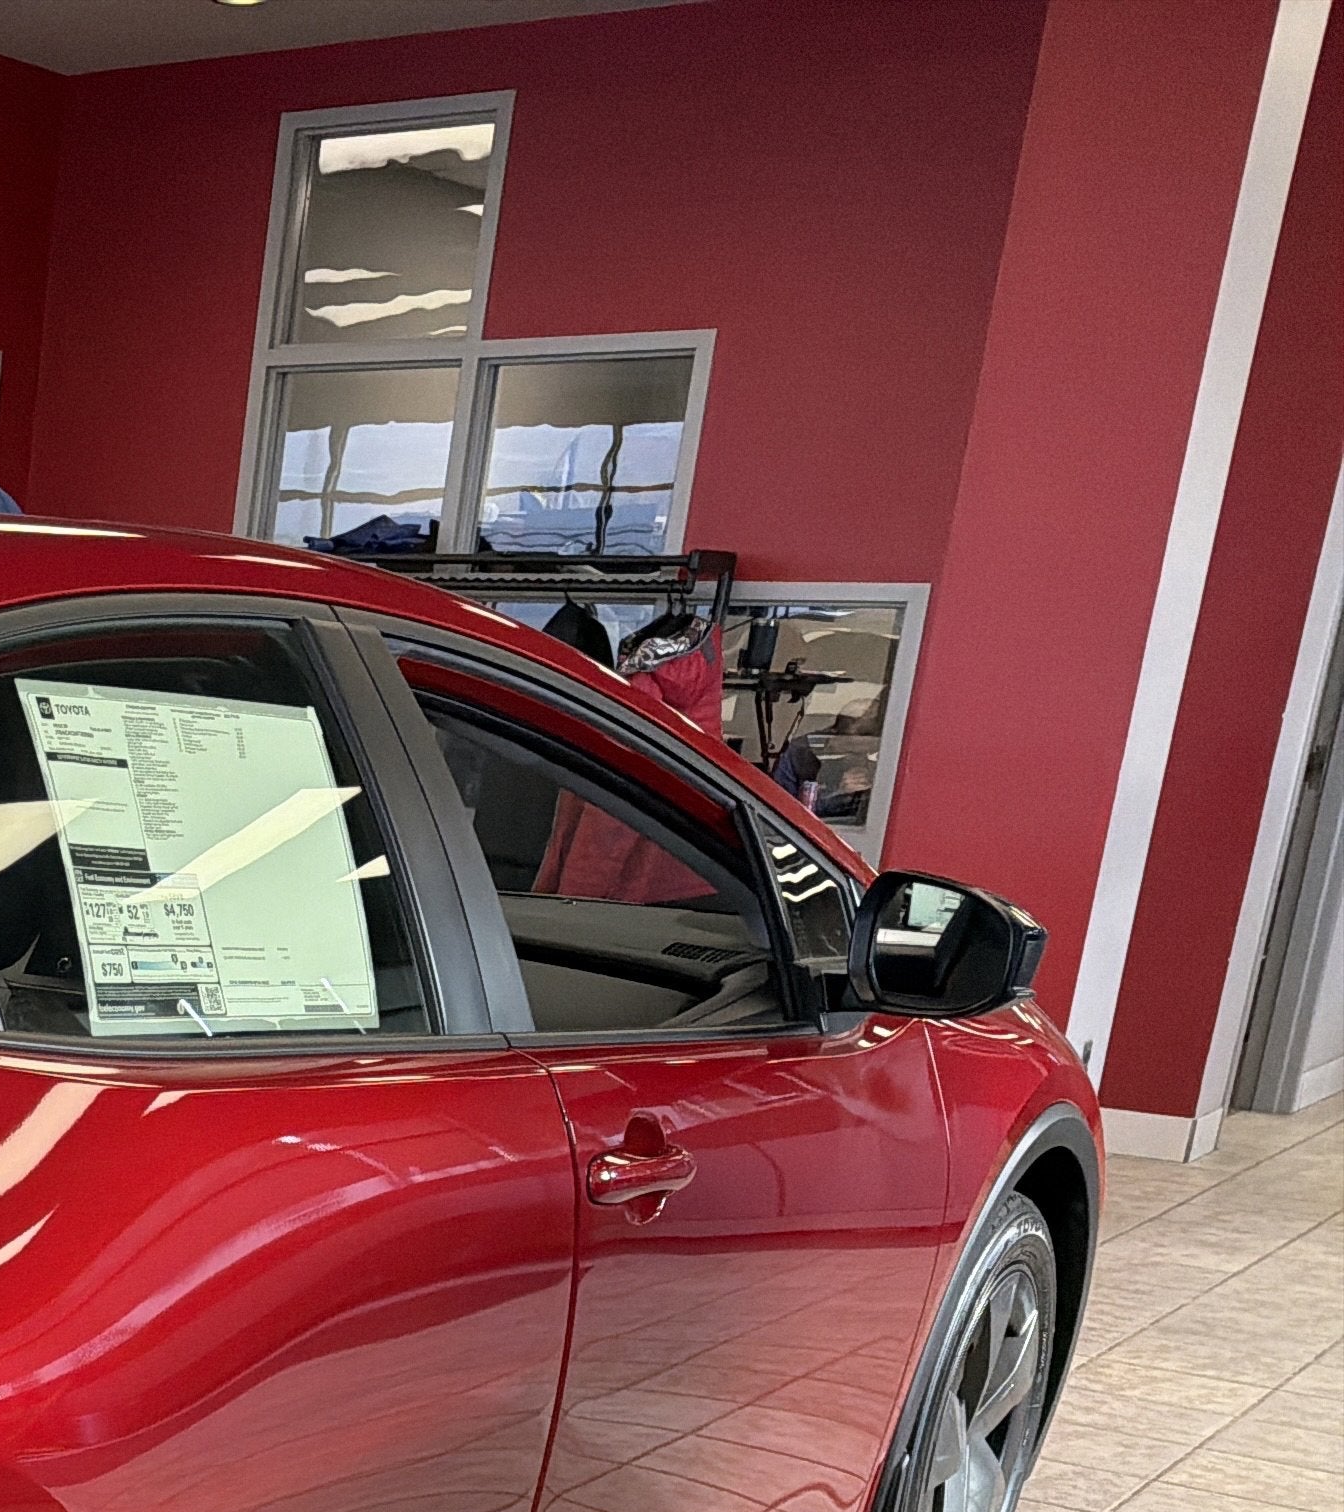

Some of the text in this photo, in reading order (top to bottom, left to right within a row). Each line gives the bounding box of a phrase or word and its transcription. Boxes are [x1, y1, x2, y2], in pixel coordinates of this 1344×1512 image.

[54, 704, 91, 716] TOYOTA
[89, 903, 106, 918] 127
[127, 905, 140, 920] 52
[163, 903, 195, 918] $4,750
[101, 962, 124, 977] $750
